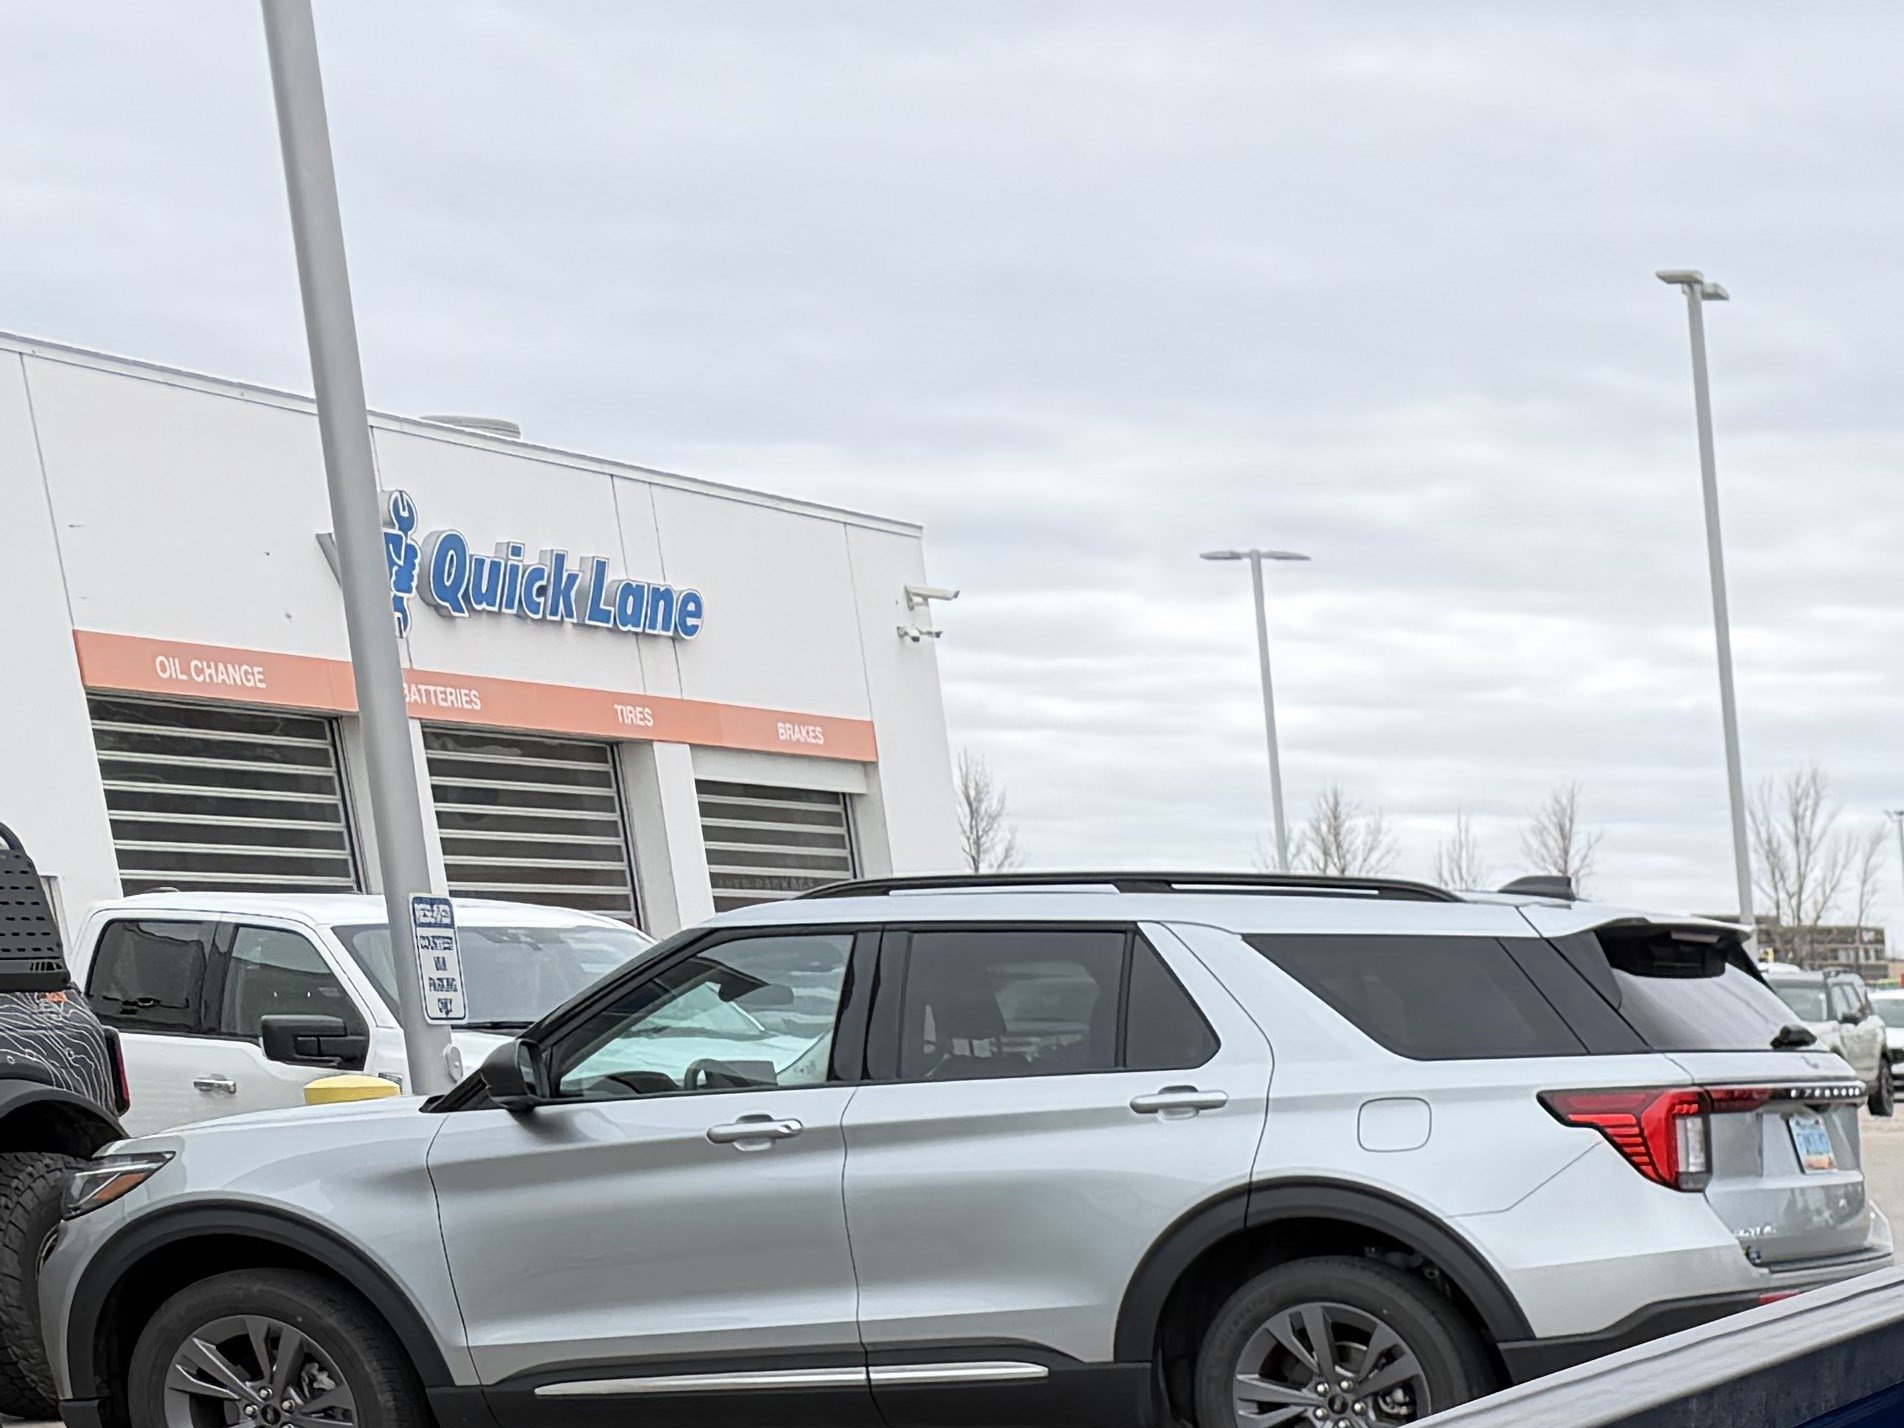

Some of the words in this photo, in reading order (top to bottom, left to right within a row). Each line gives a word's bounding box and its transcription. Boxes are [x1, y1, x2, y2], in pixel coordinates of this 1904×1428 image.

[430, 530, 582, 617] Quick
[585, 556, 704, 639] Lane
[155, 655, 188, 681] OIL
[190, 660, 267, 688] CHANGE
[614, 704, 653, 727] TIRES
[777, 722, 824, 744] BRAKES
